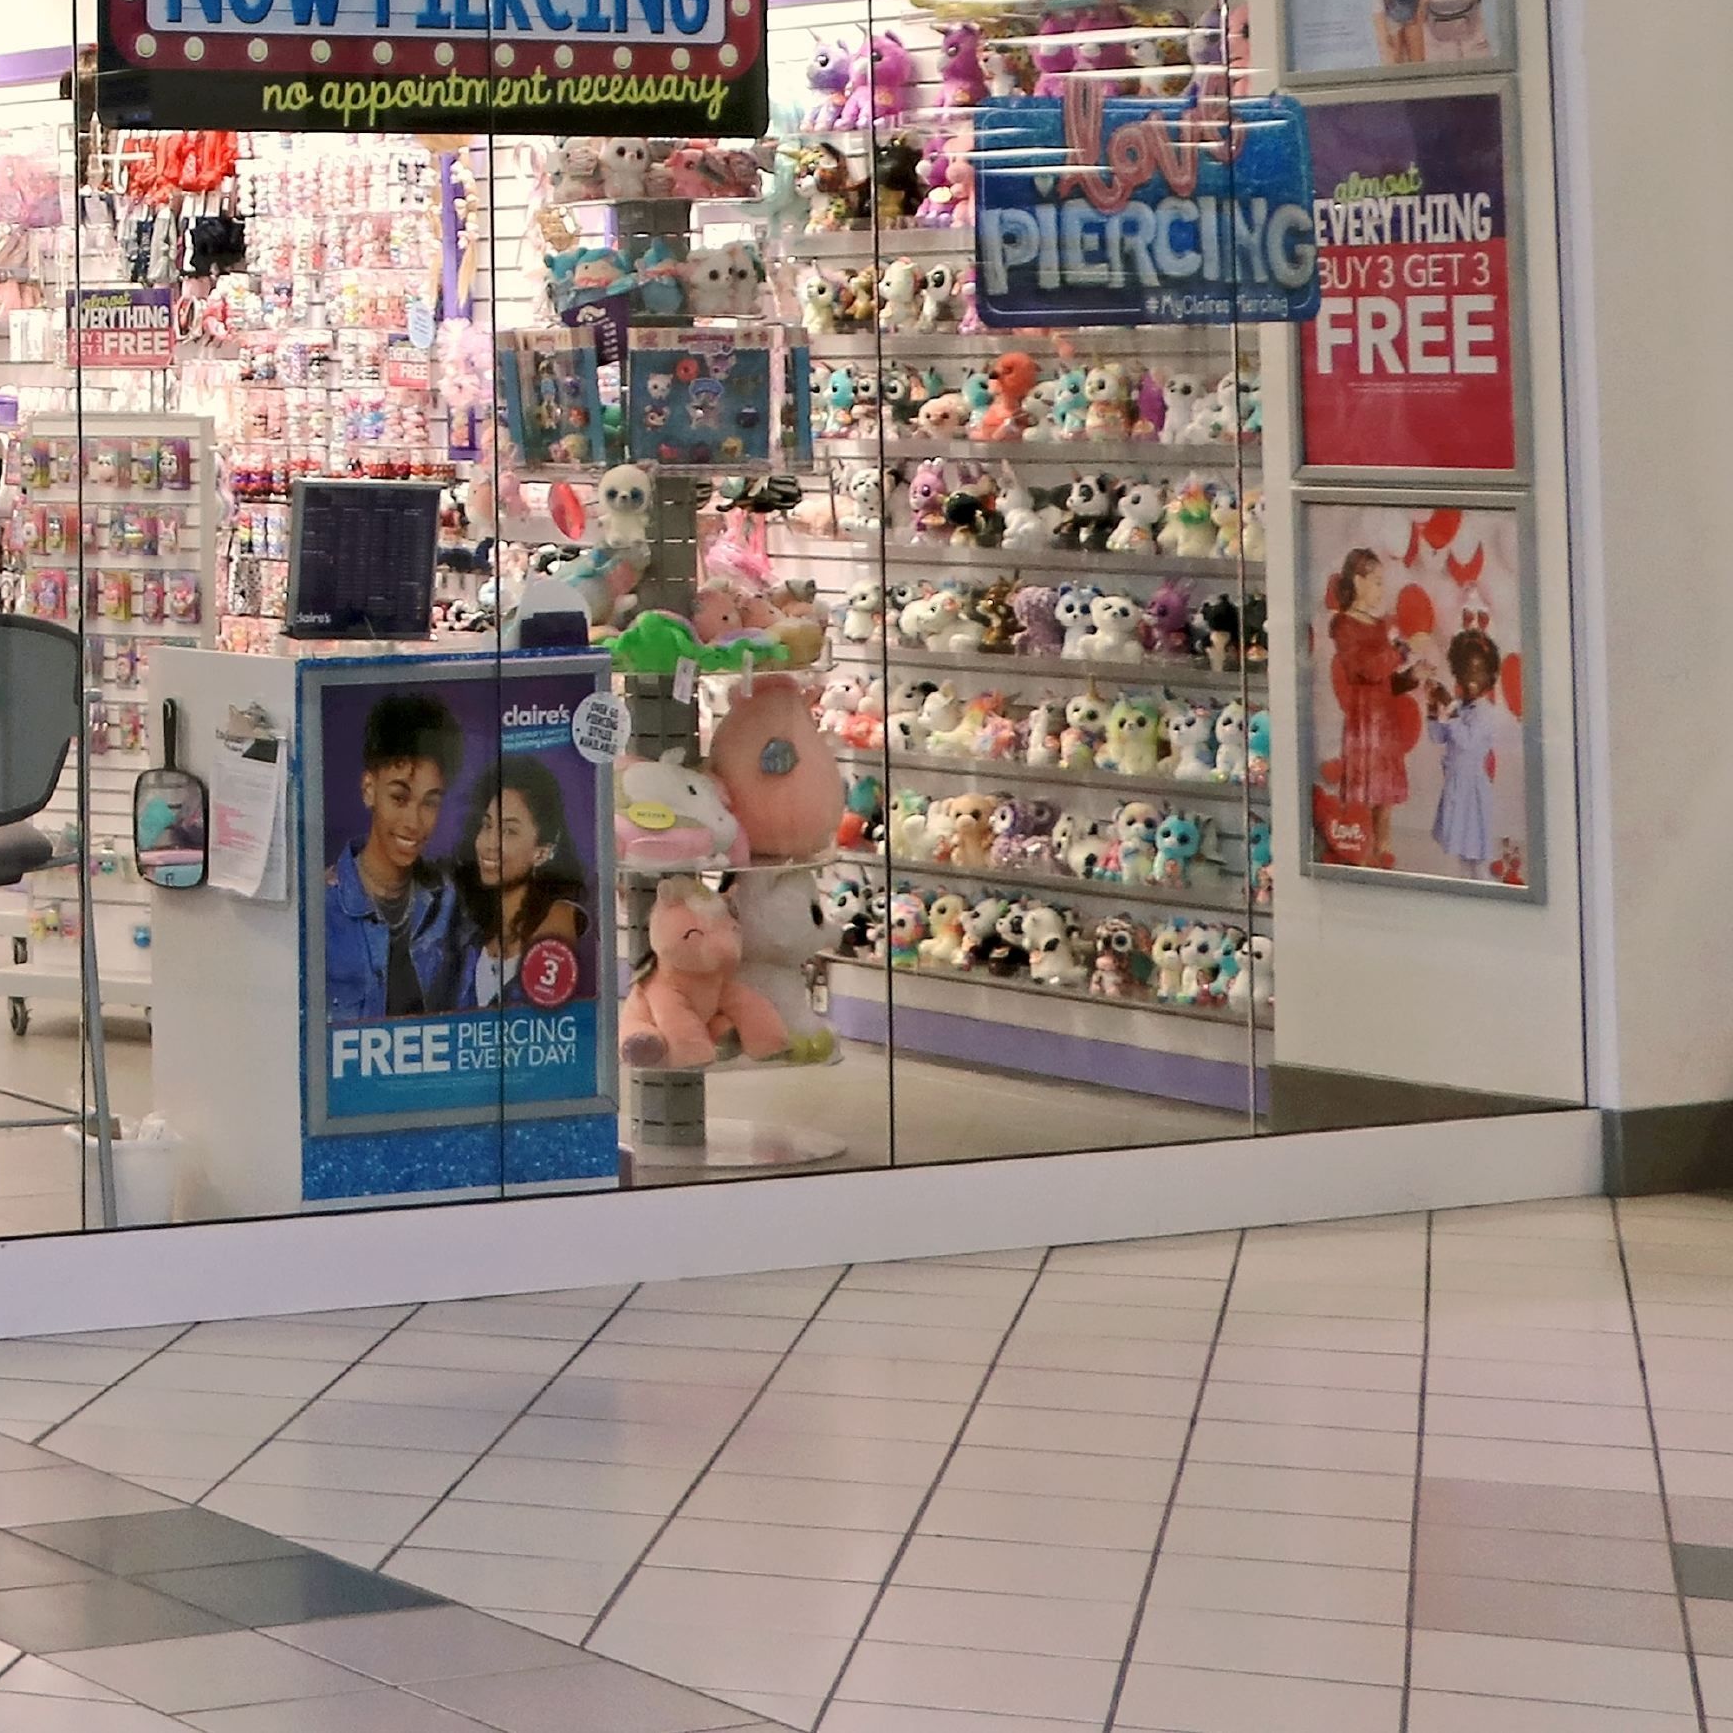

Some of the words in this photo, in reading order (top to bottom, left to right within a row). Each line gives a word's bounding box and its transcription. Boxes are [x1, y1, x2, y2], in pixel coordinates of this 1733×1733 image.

[263, 78, 313, 113] no
[319, 66, 553, 127] appointment
[557, 71, 731, 120] necessary
[1334, 162, 1423, 203] almost
[1315, 192, 1492, 247] EVERYTHING
[981, 195, 1318, 297] PIERCING
[1317, 255, 1370, 289] BUY
[1376, 254, 1393, 288] 3
[1403, 252, 1459, 288] GET
[1471, 251, 1490, 286] 3
[103, 330, 171, 356] FREE
[1316, 294, 1499, 374] FREE
[295, 612, 332, 624] claire's
[502, 703, 571, 726] claire's
[539, 959, 559, 987] 3
[333, 1023, 451, 1079] FREE
[457, 1015, 576, 1048] PIERCING
[457, 1045, 523, 1070] EVERY
[528, 1043, 576, 1067] DAY!
